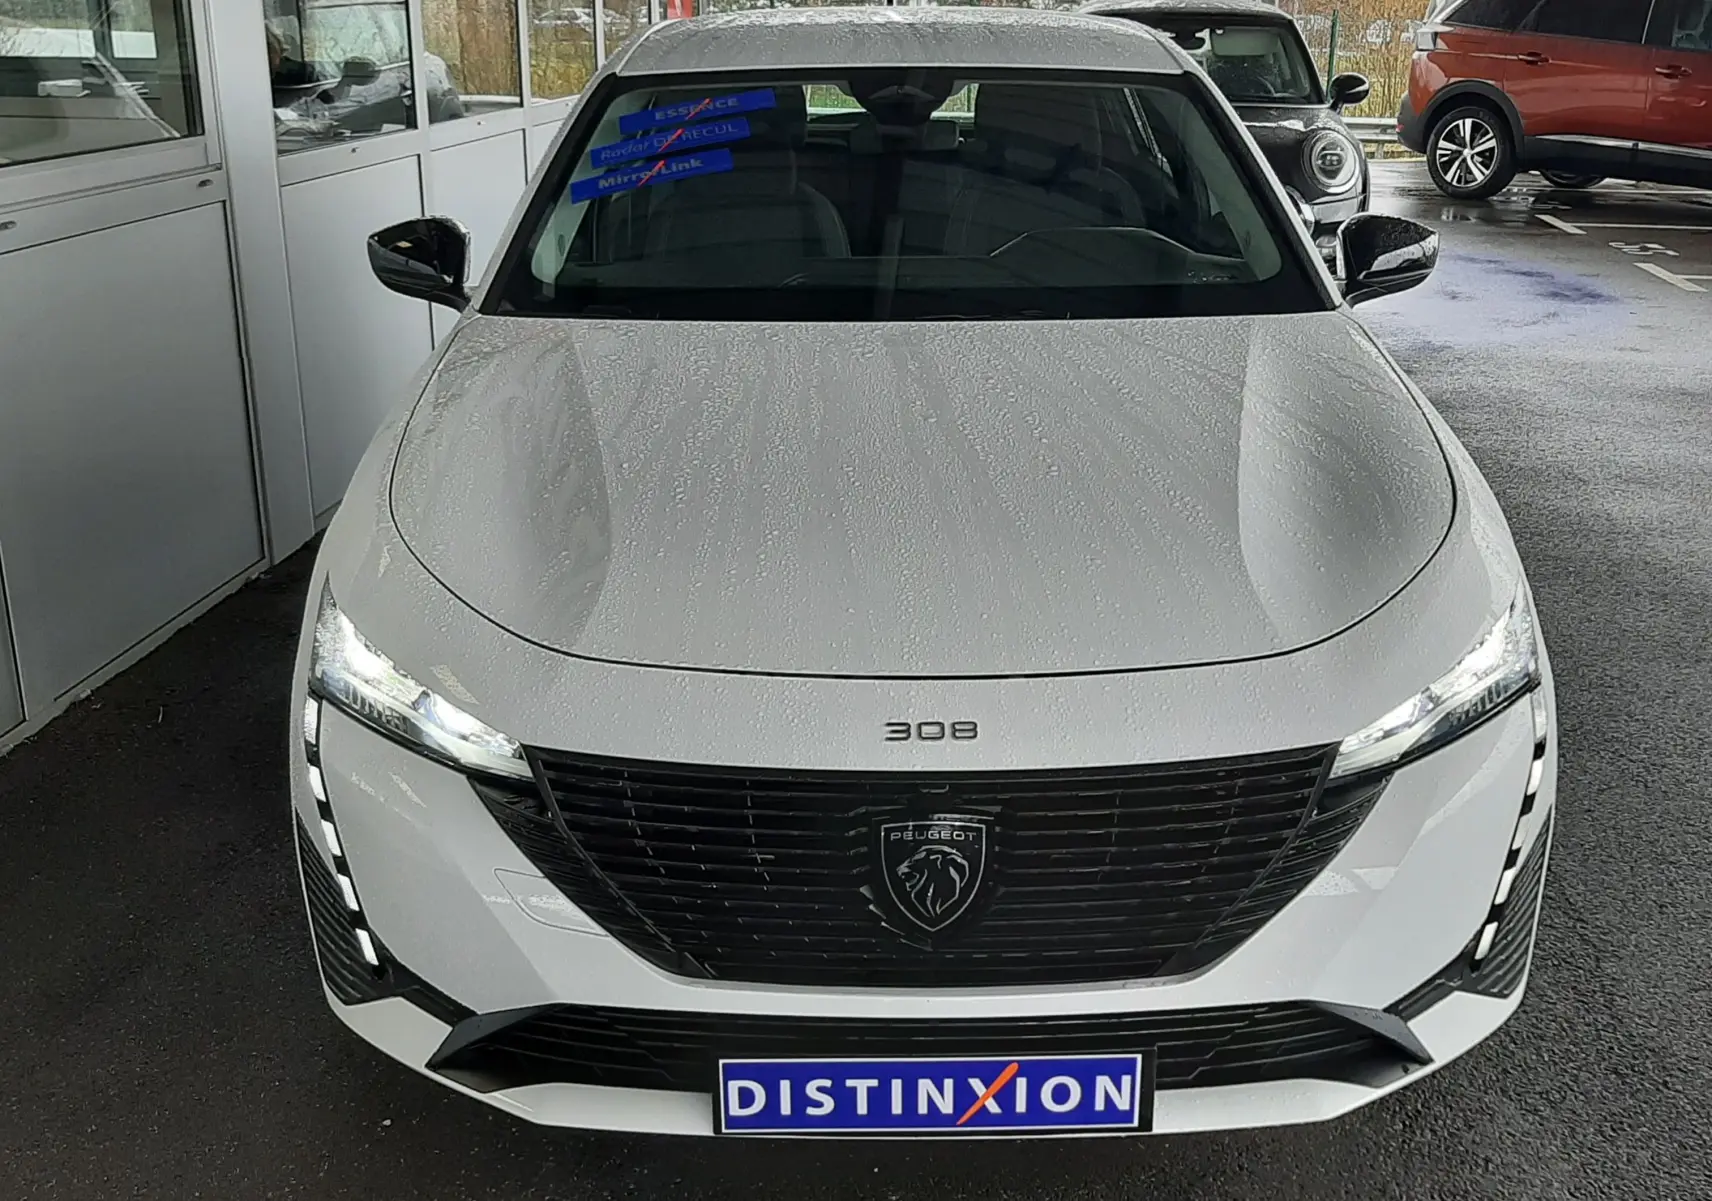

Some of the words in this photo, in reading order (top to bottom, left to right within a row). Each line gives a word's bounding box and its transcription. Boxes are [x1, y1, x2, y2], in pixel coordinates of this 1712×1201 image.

[654, 98, 740, 121] ESSENCE
[884, 721, 978, 742] 308
[889, 830, 978, 842] PEUGEOT
[727, 1063, 1132, 1124] DISTINXION
